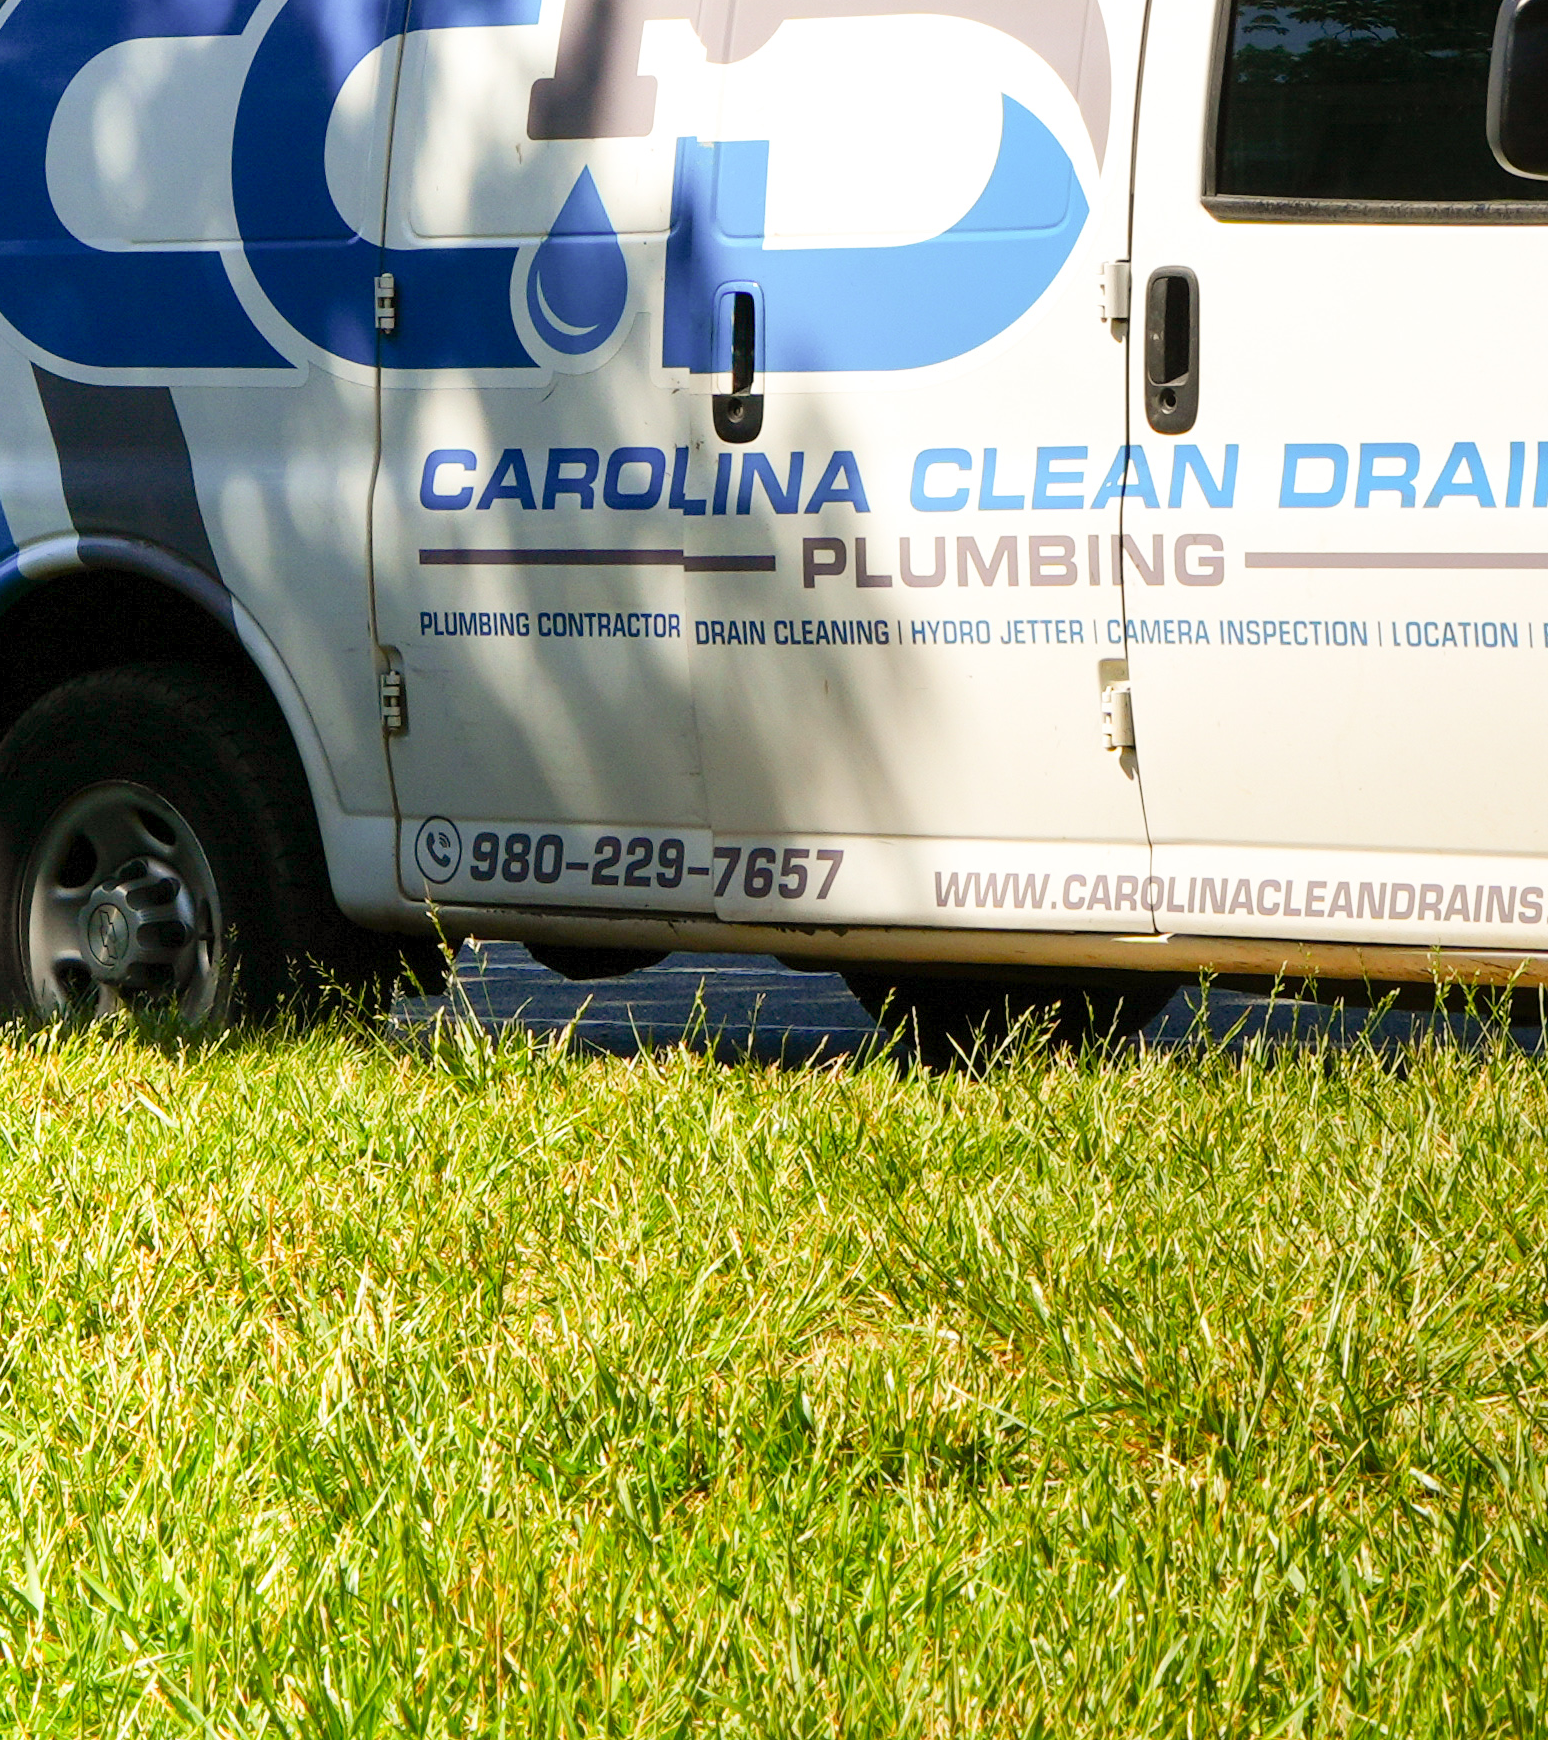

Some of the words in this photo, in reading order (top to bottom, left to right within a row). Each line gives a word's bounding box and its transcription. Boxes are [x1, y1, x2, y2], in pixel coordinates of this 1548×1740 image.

[419, 446, 871, 516] CAROLINA
[909, 443, 1240, 513] CLEAN
[802, 533, 1225, 589] PLUMBING
[419, 611, 530, 638] PLUMBING
[537, 611, 681, 639] CONTRACTOR
[695, 619, 766, 646] DRAIN
[774, 619, 890, 646] CLEANING
[911, 619, 991, 646] HYDRO
[1000, 619, 1084, 646] JETTER
[1107, 619, 1211, 646] CAMERA
[1219, 619, 1369, 648] INSPECTION
[1392, 620, 1519, 649] LOCATION
[469, 831, 845, 901] 980-229-7657
